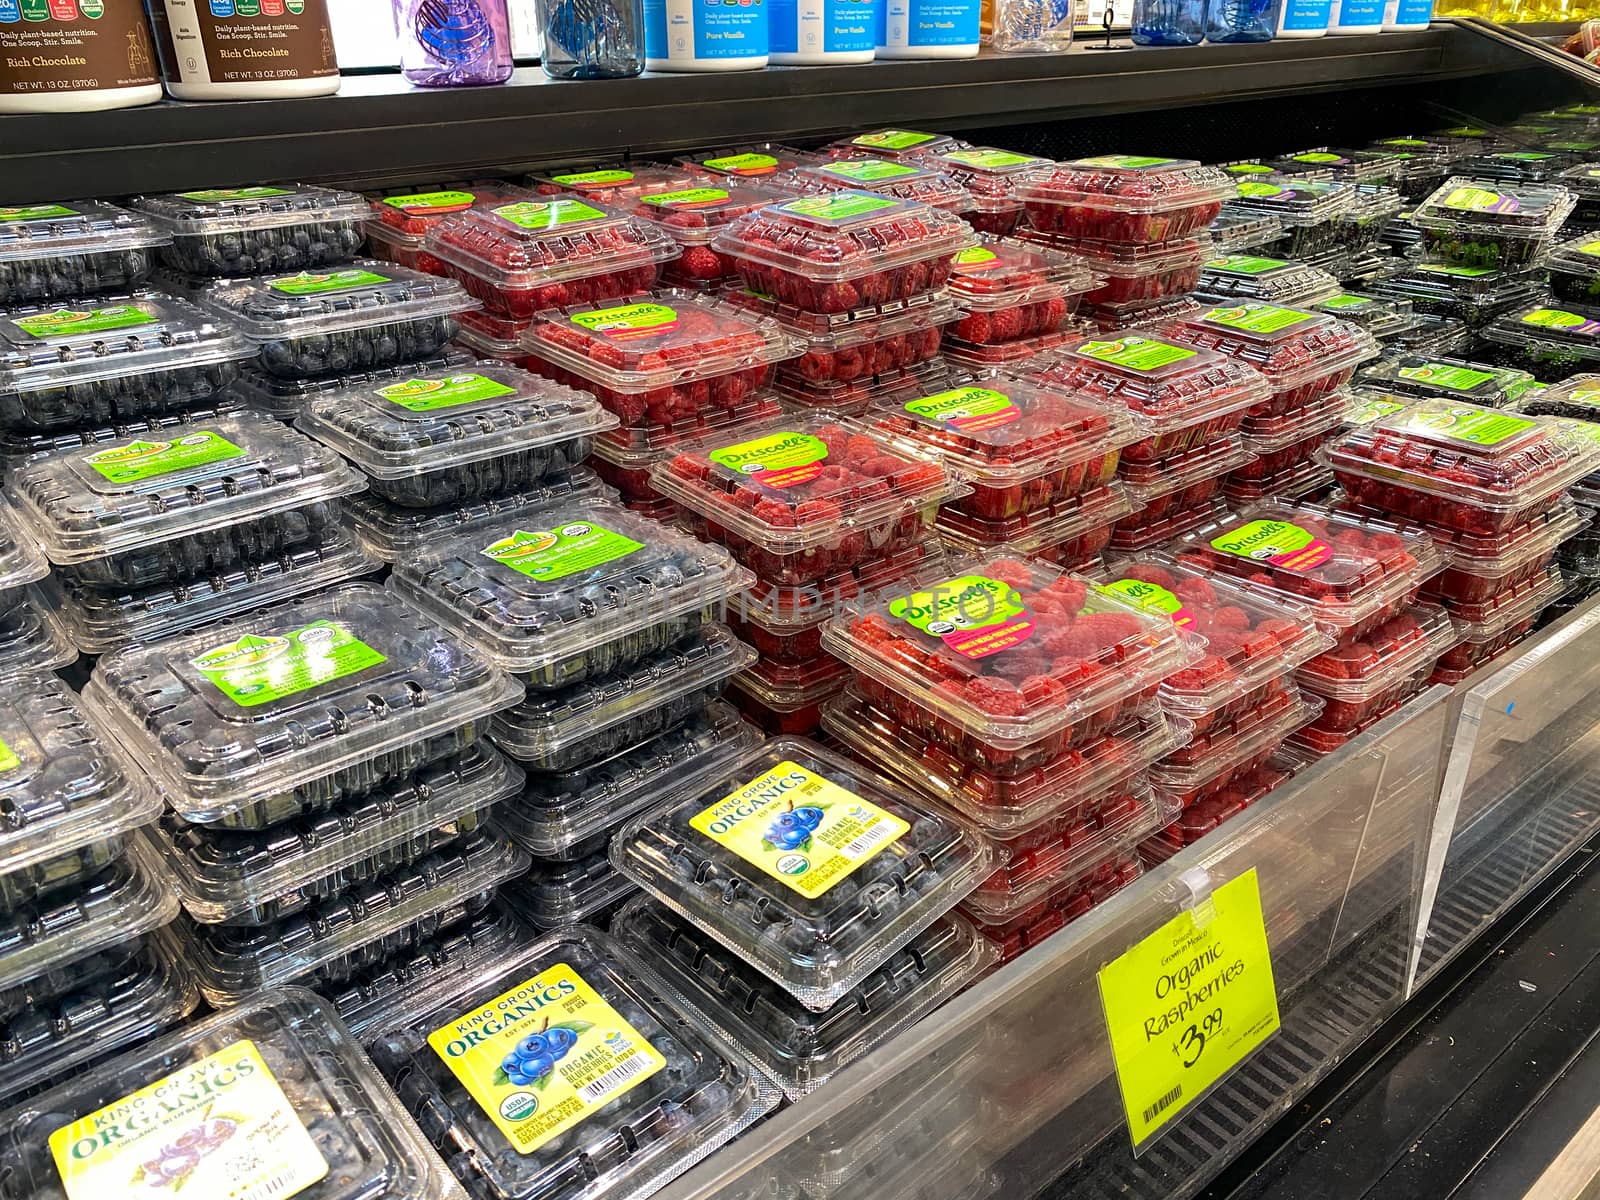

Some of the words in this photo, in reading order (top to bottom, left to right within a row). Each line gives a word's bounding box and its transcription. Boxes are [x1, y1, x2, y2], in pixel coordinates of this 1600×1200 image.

[20, 29, 64, 39] plant-based
[65, 29, 98, 37] nutrition.
[215, 25, 233, 33] Daily
[233, 24, 271, 32] plant-based
[18, 39, 43, 48] Scoop.
[61, 37, 84, 45] Smile.
[220, 49, 241, 58] Rich
[243, 47, 289, 58] Chocolate
[7, 57, 31, 68] Rich
[32, 55, 86, 68] Chocolate
[224, 71, 239, 80] NET
[240, 71, 252, 79] WT.
[254, 70, 263, 78] 13
[265, 70, 276, 78] OZ.
[276, 69, 298, 78] (370G)
[30, 81, 45, 89] WT.
[47, 81, 56, 89] 13
[58, 80, 70, 89] OZ.
[72, 78, 99, 89] (370G)
[913, 390, 992, 413] Driscoll's
[720, 436, 811, 463] Driscoll's
[709, 772, 807, 834] ORGANICS
[712, 798, 741, 817] KING
[742, 774, 779, 799] GROVE
[817, 817, 853, 842] ORGANIC
[1156, 942, 1224, 1000] Organic
[456, 1009, 494, 1033] KING
[497, 980, 546, 1011] GROVE
[1144, 960, 1245, 1042] Raspberries
[446, 979, 576, 1057] ORGANICS
[560, 1045, 605, 1077] ORGANIC
[566, 1051, 614, 1084] BLUEBERRIES
[72, 1058, 254, 1160] ORGANICS
[94, 1097, 145, 1128] KING
[505, 1096, 527, 1111] USDA
